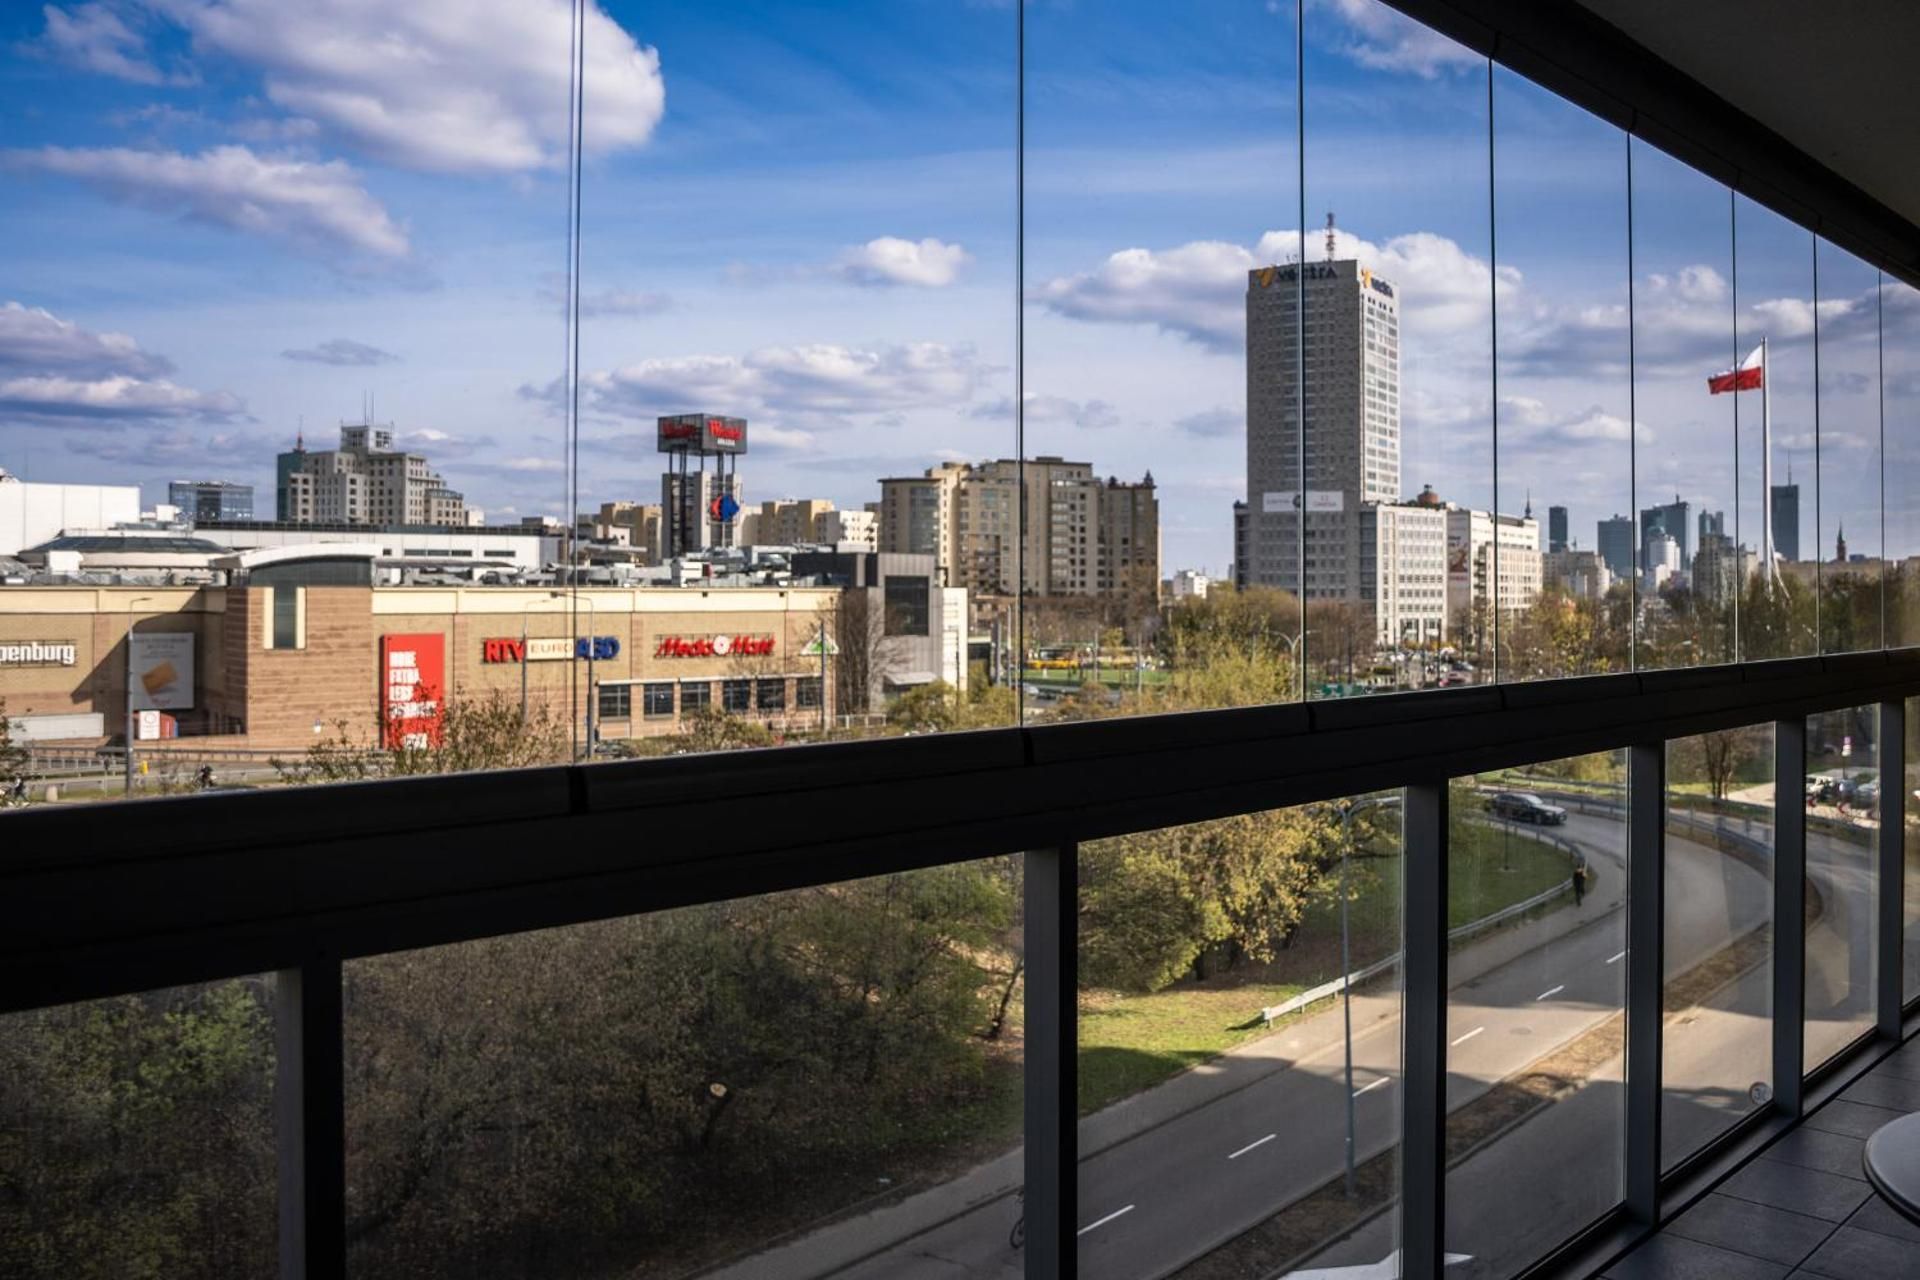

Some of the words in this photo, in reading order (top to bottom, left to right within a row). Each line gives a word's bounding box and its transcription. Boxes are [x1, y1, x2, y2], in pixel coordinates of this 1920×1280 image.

[484, 638, 525, 663] RTV
[530, 642, 573, 655] EURO
[654, 636, 715, 659] Media
[729, 633, 777, 656] Markt
